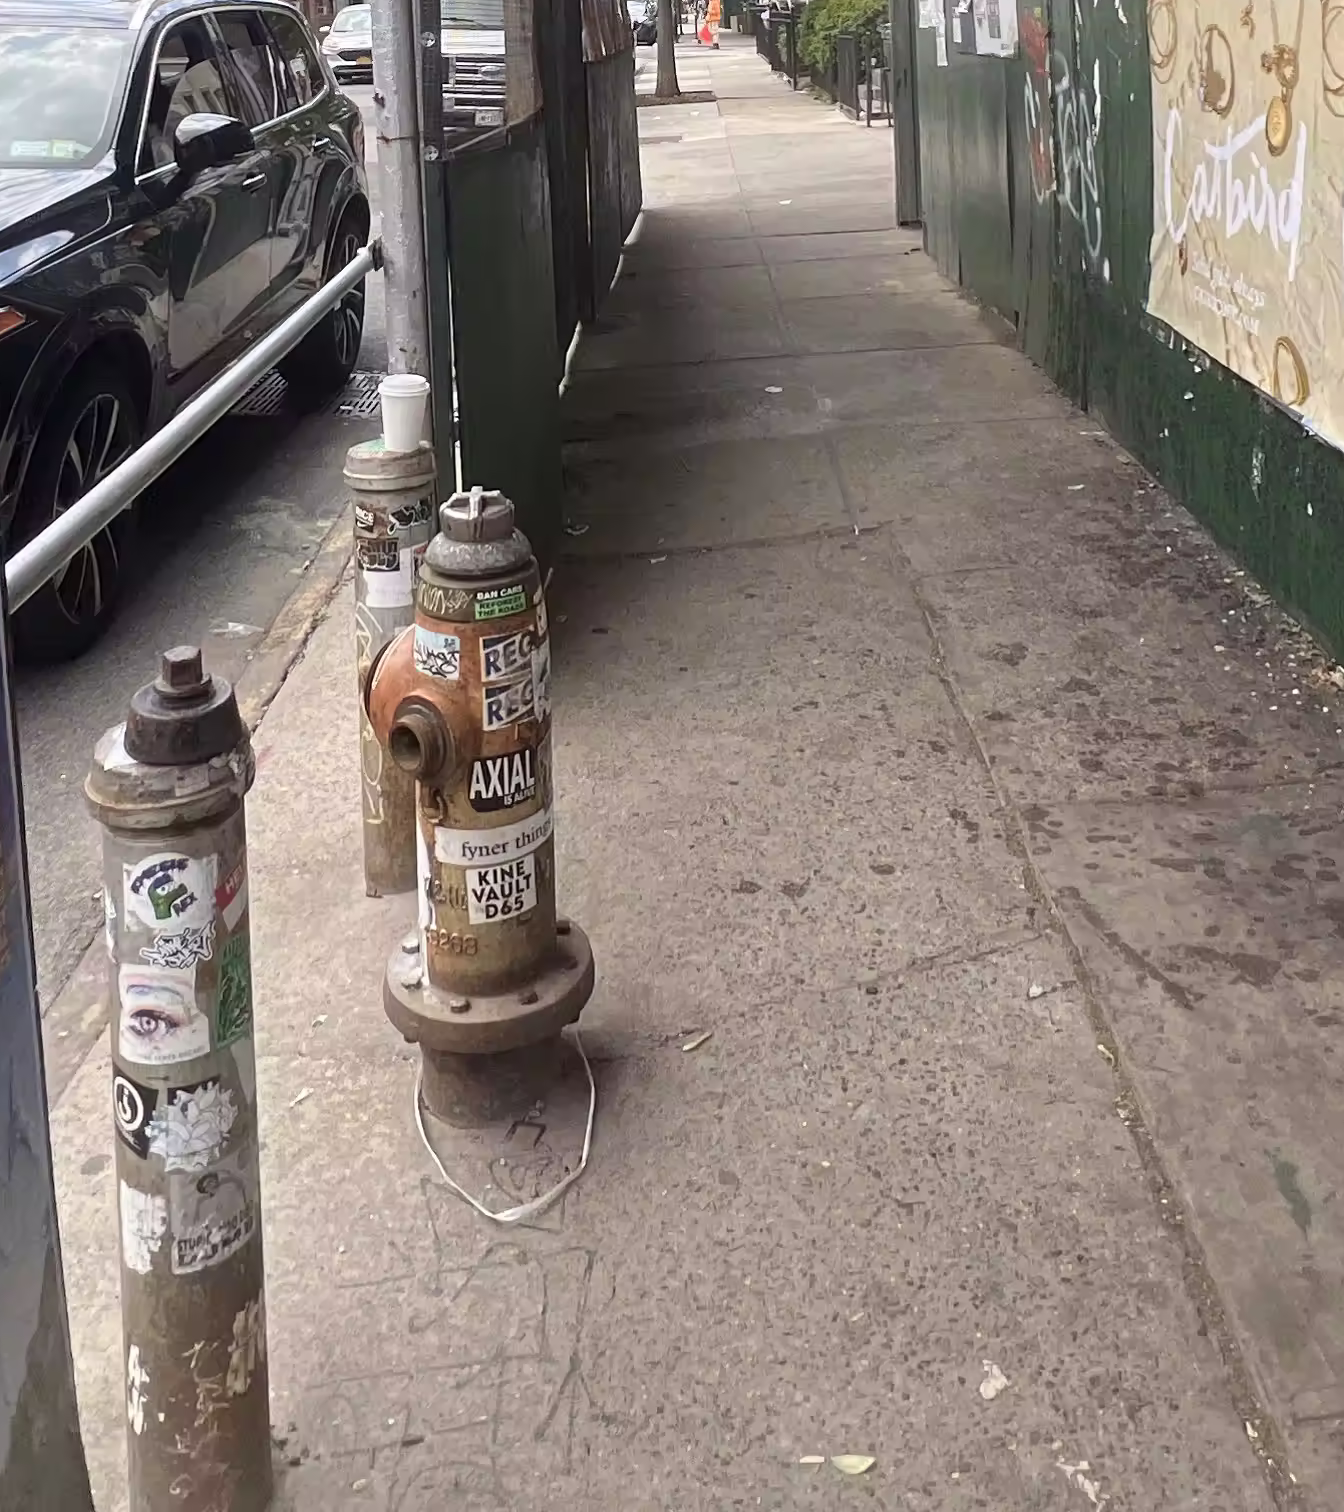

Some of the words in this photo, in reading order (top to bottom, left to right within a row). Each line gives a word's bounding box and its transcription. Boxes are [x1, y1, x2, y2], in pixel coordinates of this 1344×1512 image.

[1164, 108, 1306, 282] Catbird
[476, 591, 498, 600] BAN
[470, 749, 536, 800] AXIAL
[462, 841, 509, 861] fyner
[515, 818, 553, 850] things
[472, 872, 532, 904] VAULT
[478, 860, 526, 887] KINE
[485, 898, 525, 920] D65
